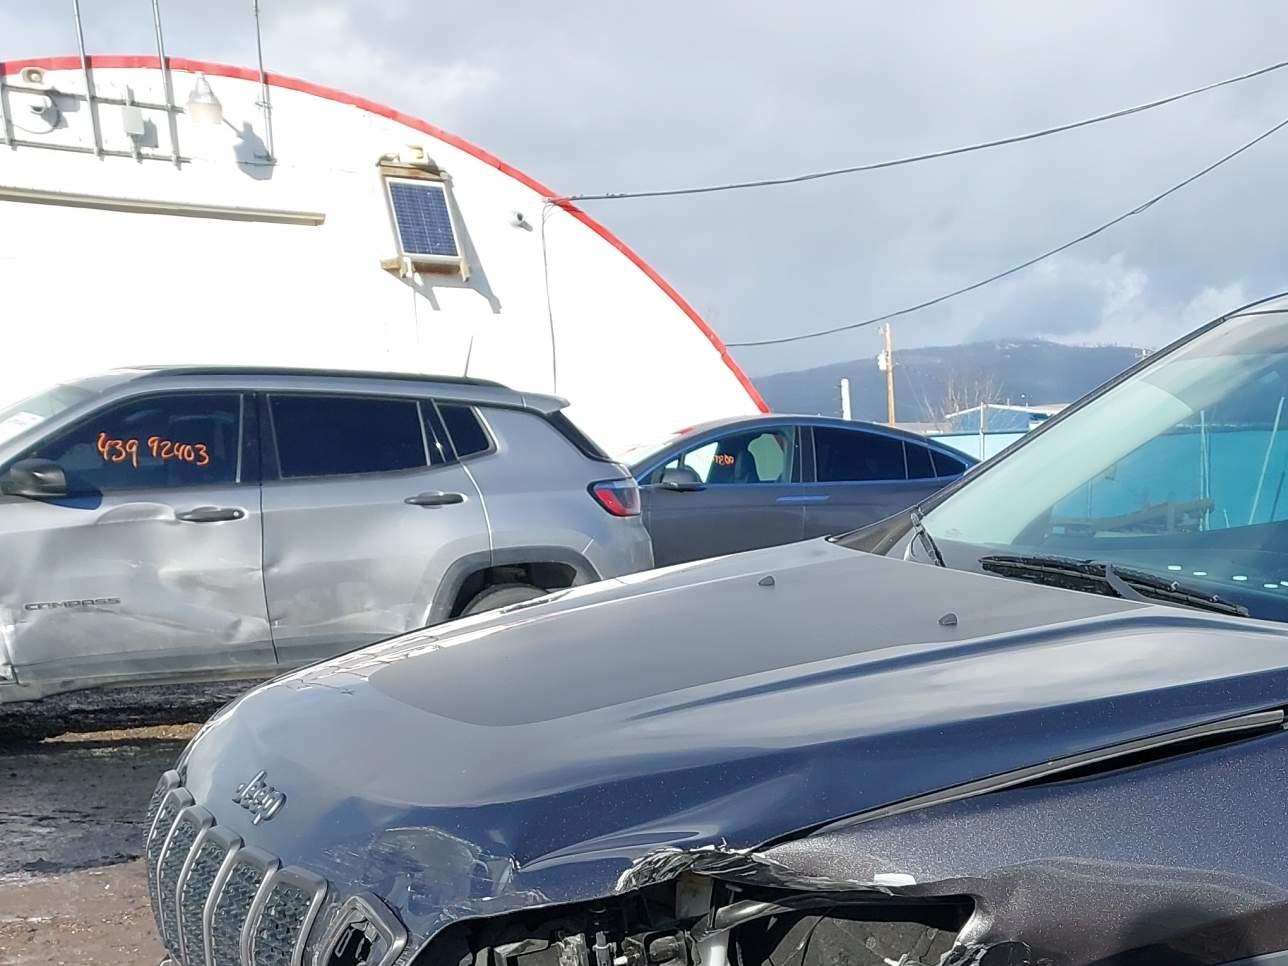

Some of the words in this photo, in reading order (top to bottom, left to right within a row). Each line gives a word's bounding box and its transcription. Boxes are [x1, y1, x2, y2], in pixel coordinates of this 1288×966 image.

[98, 432, 139, 468] 439
[148, 436, 209, 465] 92403
[25, 597, 120, 610] COMPASS
